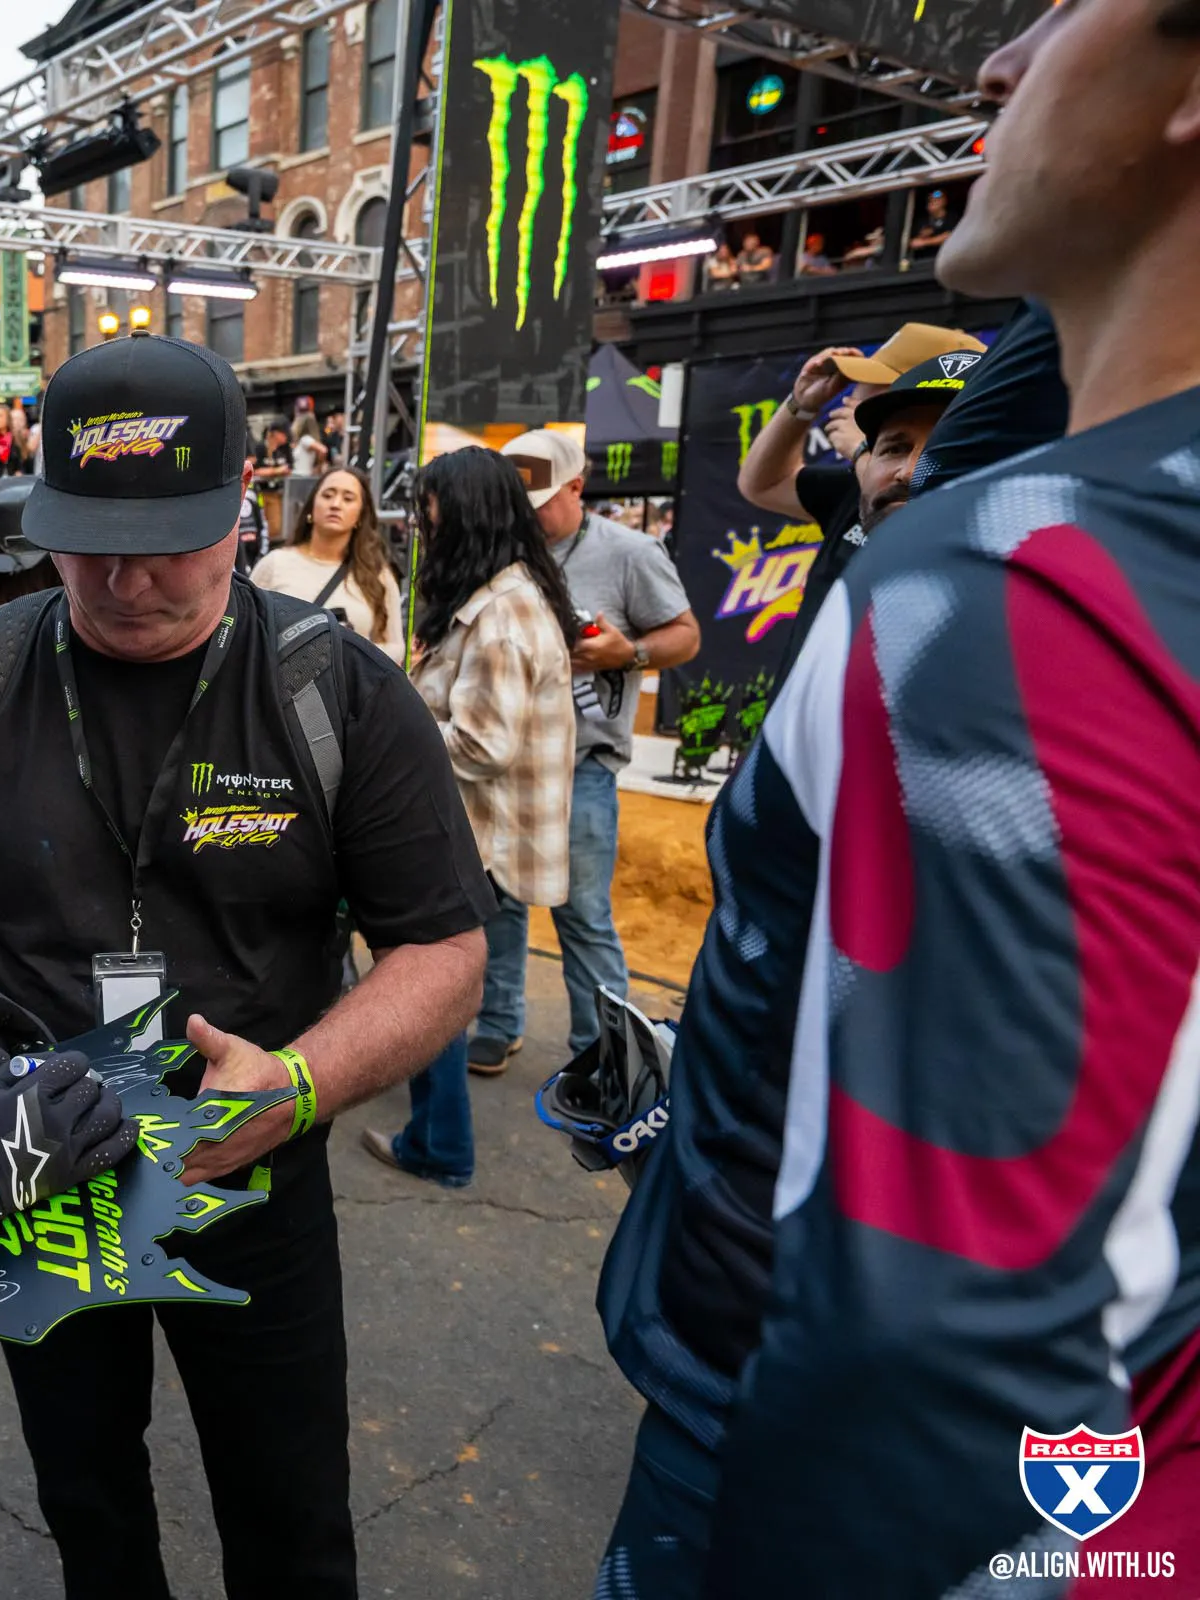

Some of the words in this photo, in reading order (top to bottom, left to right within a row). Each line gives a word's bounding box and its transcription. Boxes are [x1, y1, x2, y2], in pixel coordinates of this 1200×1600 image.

[71, 416, 187, 458] HOLESHOT
[216, 772, 295, 791] MONSTER
[182, 812, 299, 843] HOLESHOT
[32, 1186, 92, 1294] HOT
